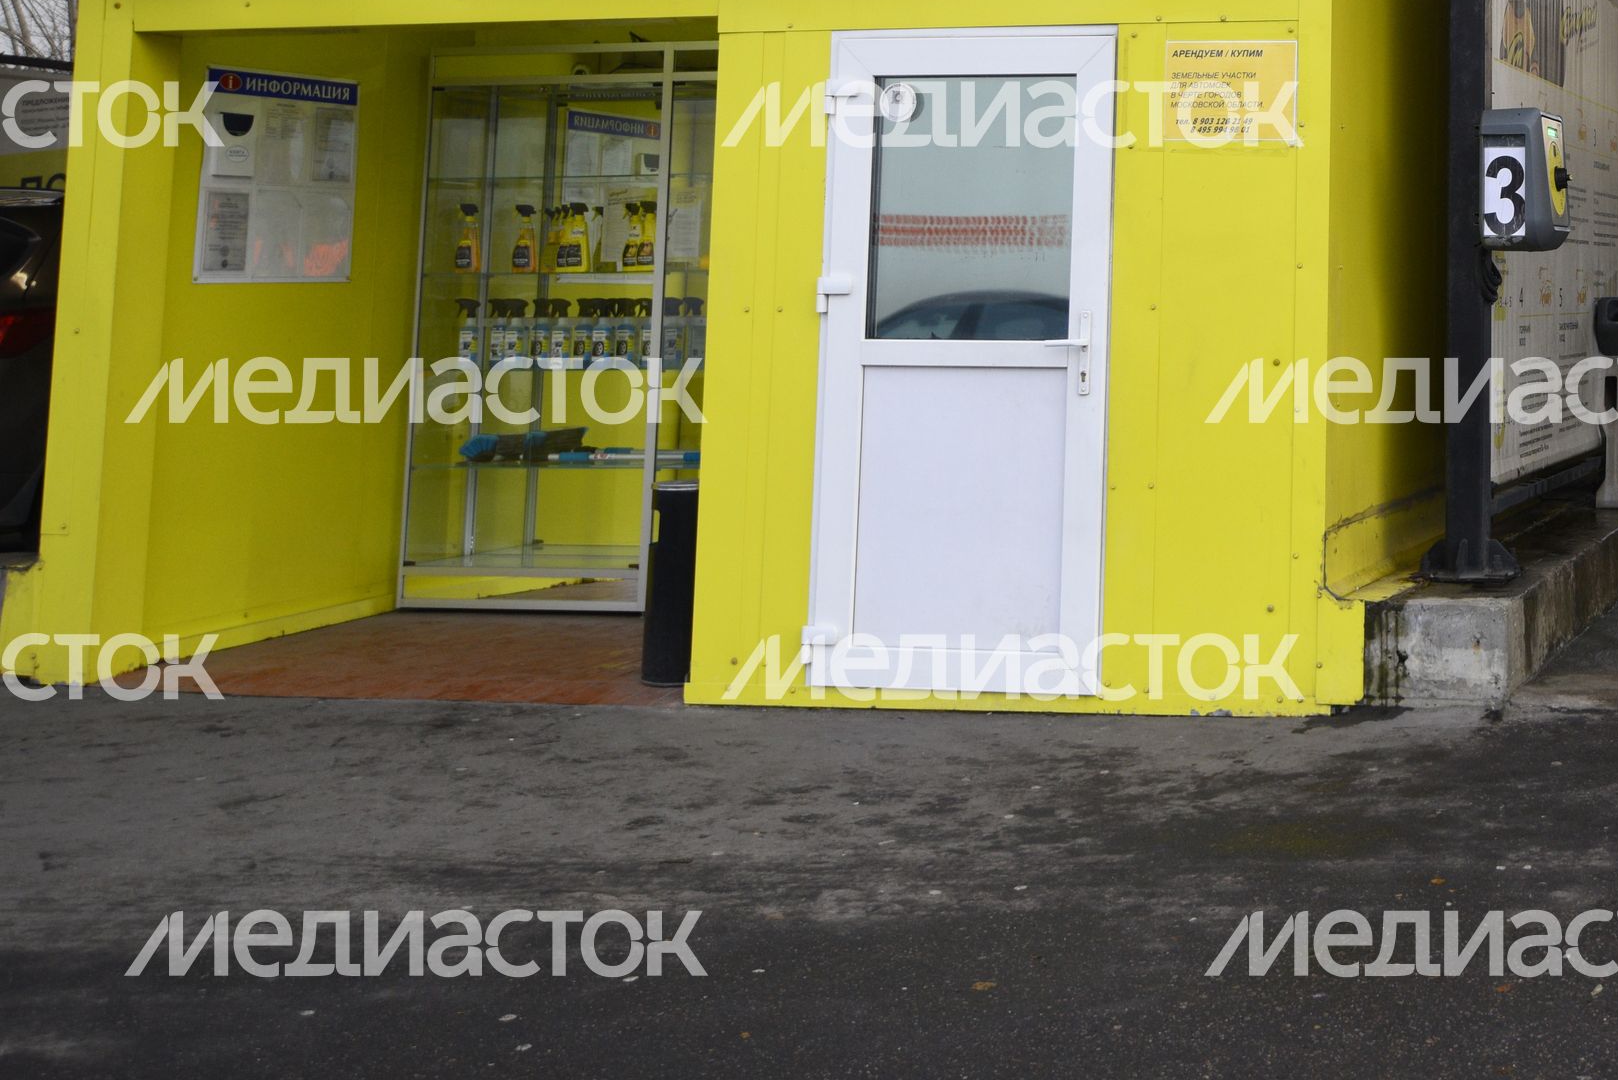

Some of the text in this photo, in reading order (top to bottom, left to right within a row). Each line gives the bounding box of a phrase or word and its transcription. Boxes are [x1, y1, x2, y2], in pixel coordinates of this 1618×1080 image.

[1172, 49, 1223, 59] АРЕНДУЕМ
[1230, 49, 1263, 58] КУПИМ
[246, 76, 351, 101] ИНФОРМАЦИЯ
[1484, 155, 1526, 237] 3
